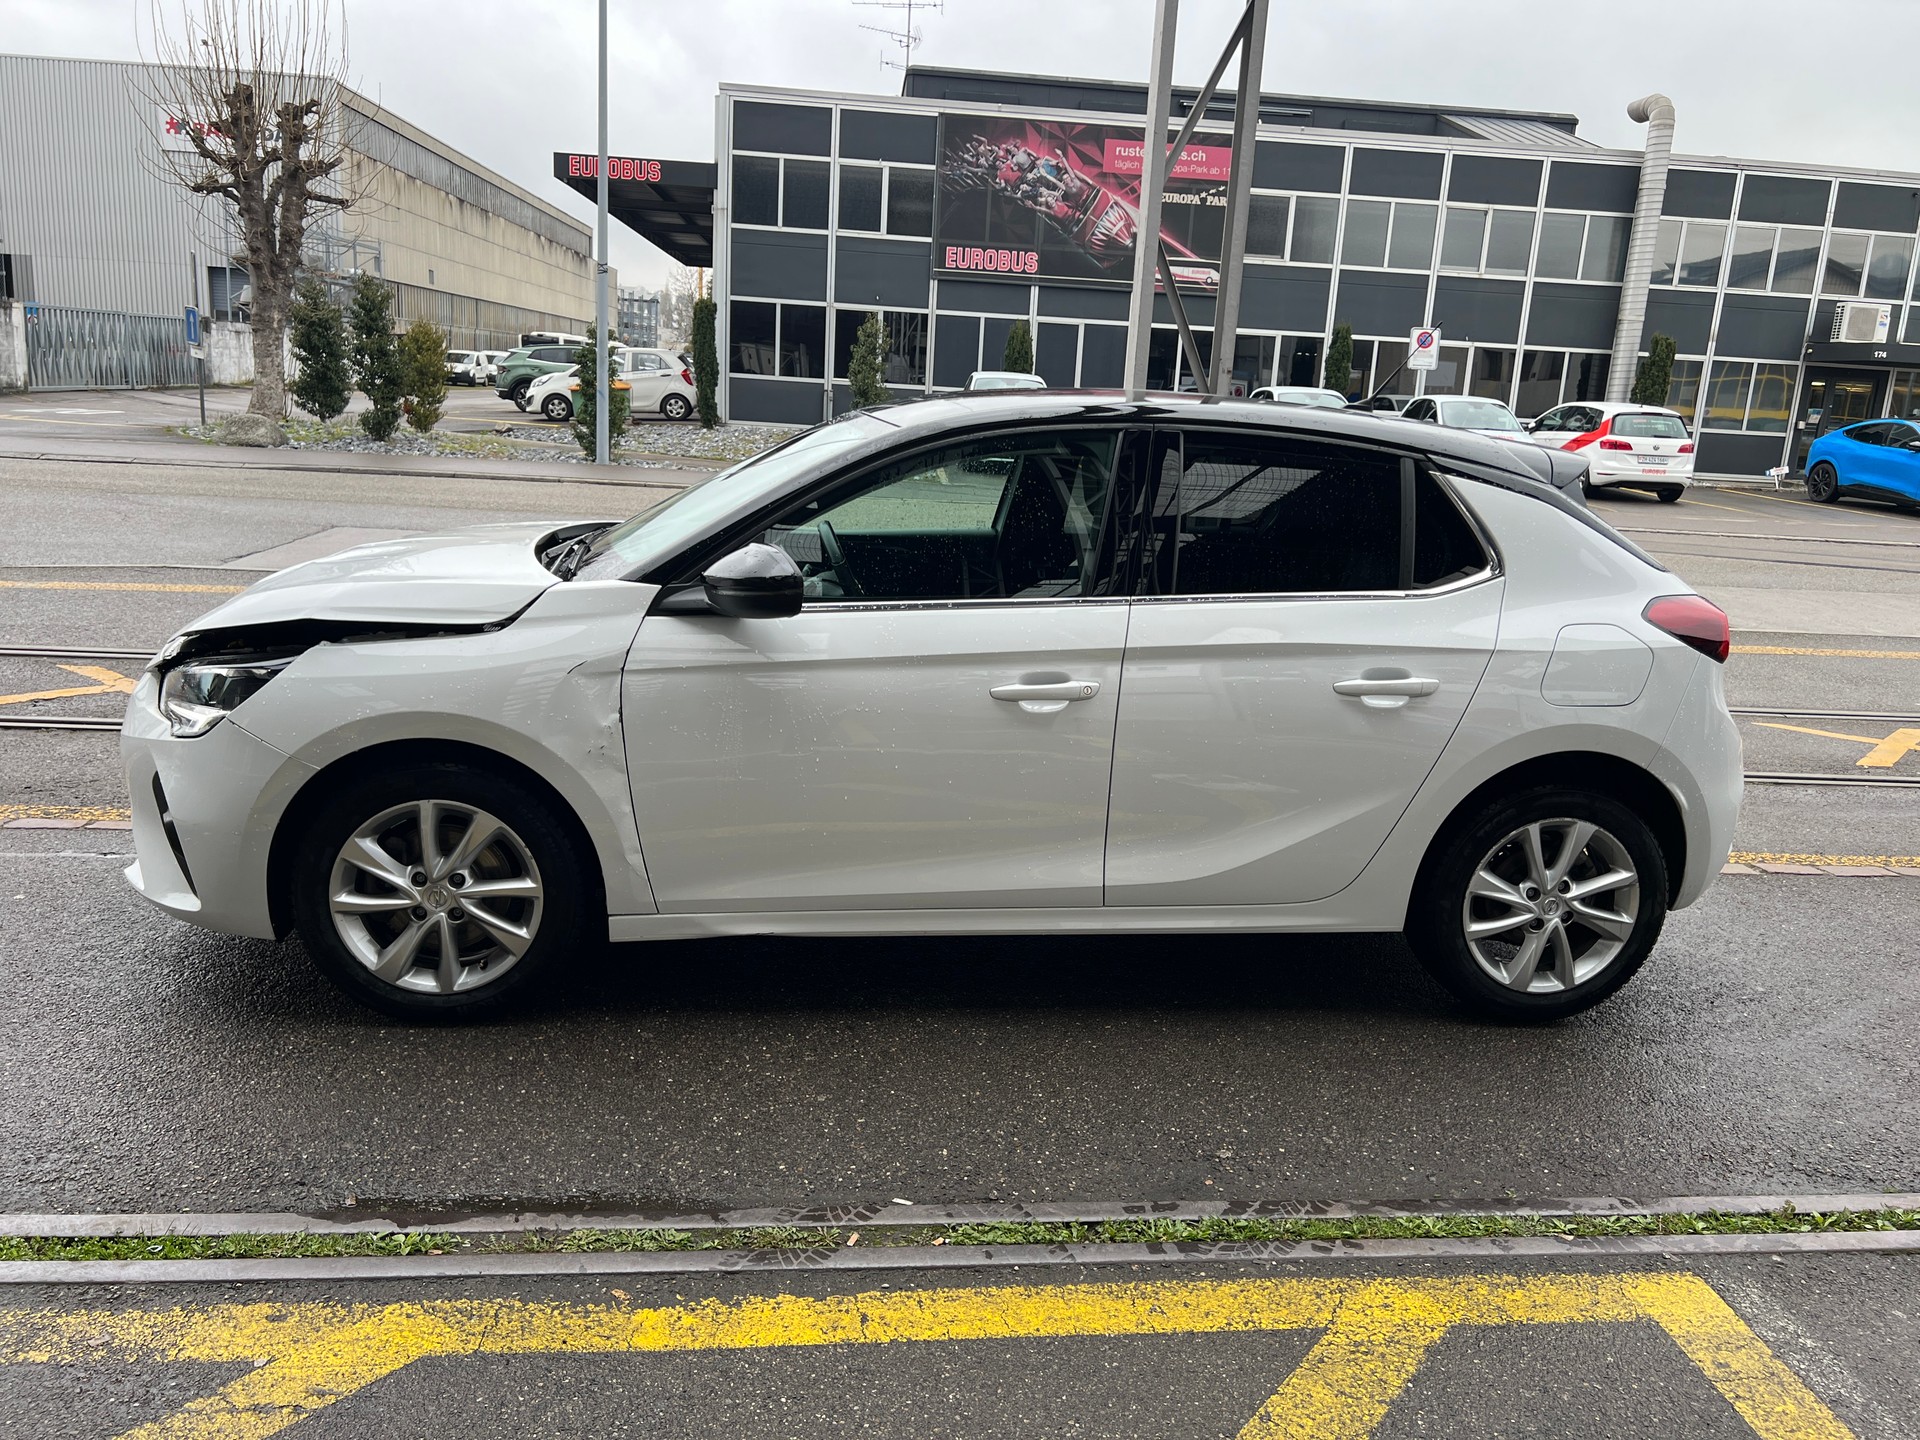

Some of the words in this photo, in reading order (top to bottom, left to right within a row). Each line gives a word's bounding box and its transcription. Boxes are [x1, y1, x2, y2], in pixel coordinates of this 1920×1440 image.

[1114, 159, 1140, 170] täglich
[1209, 166, 1220, 175] ab
[1206, 196, 1228, 207] PAR
[945, 246, 1038, 273] EUROBUS
[1874, 351, 1887, 359] 174
